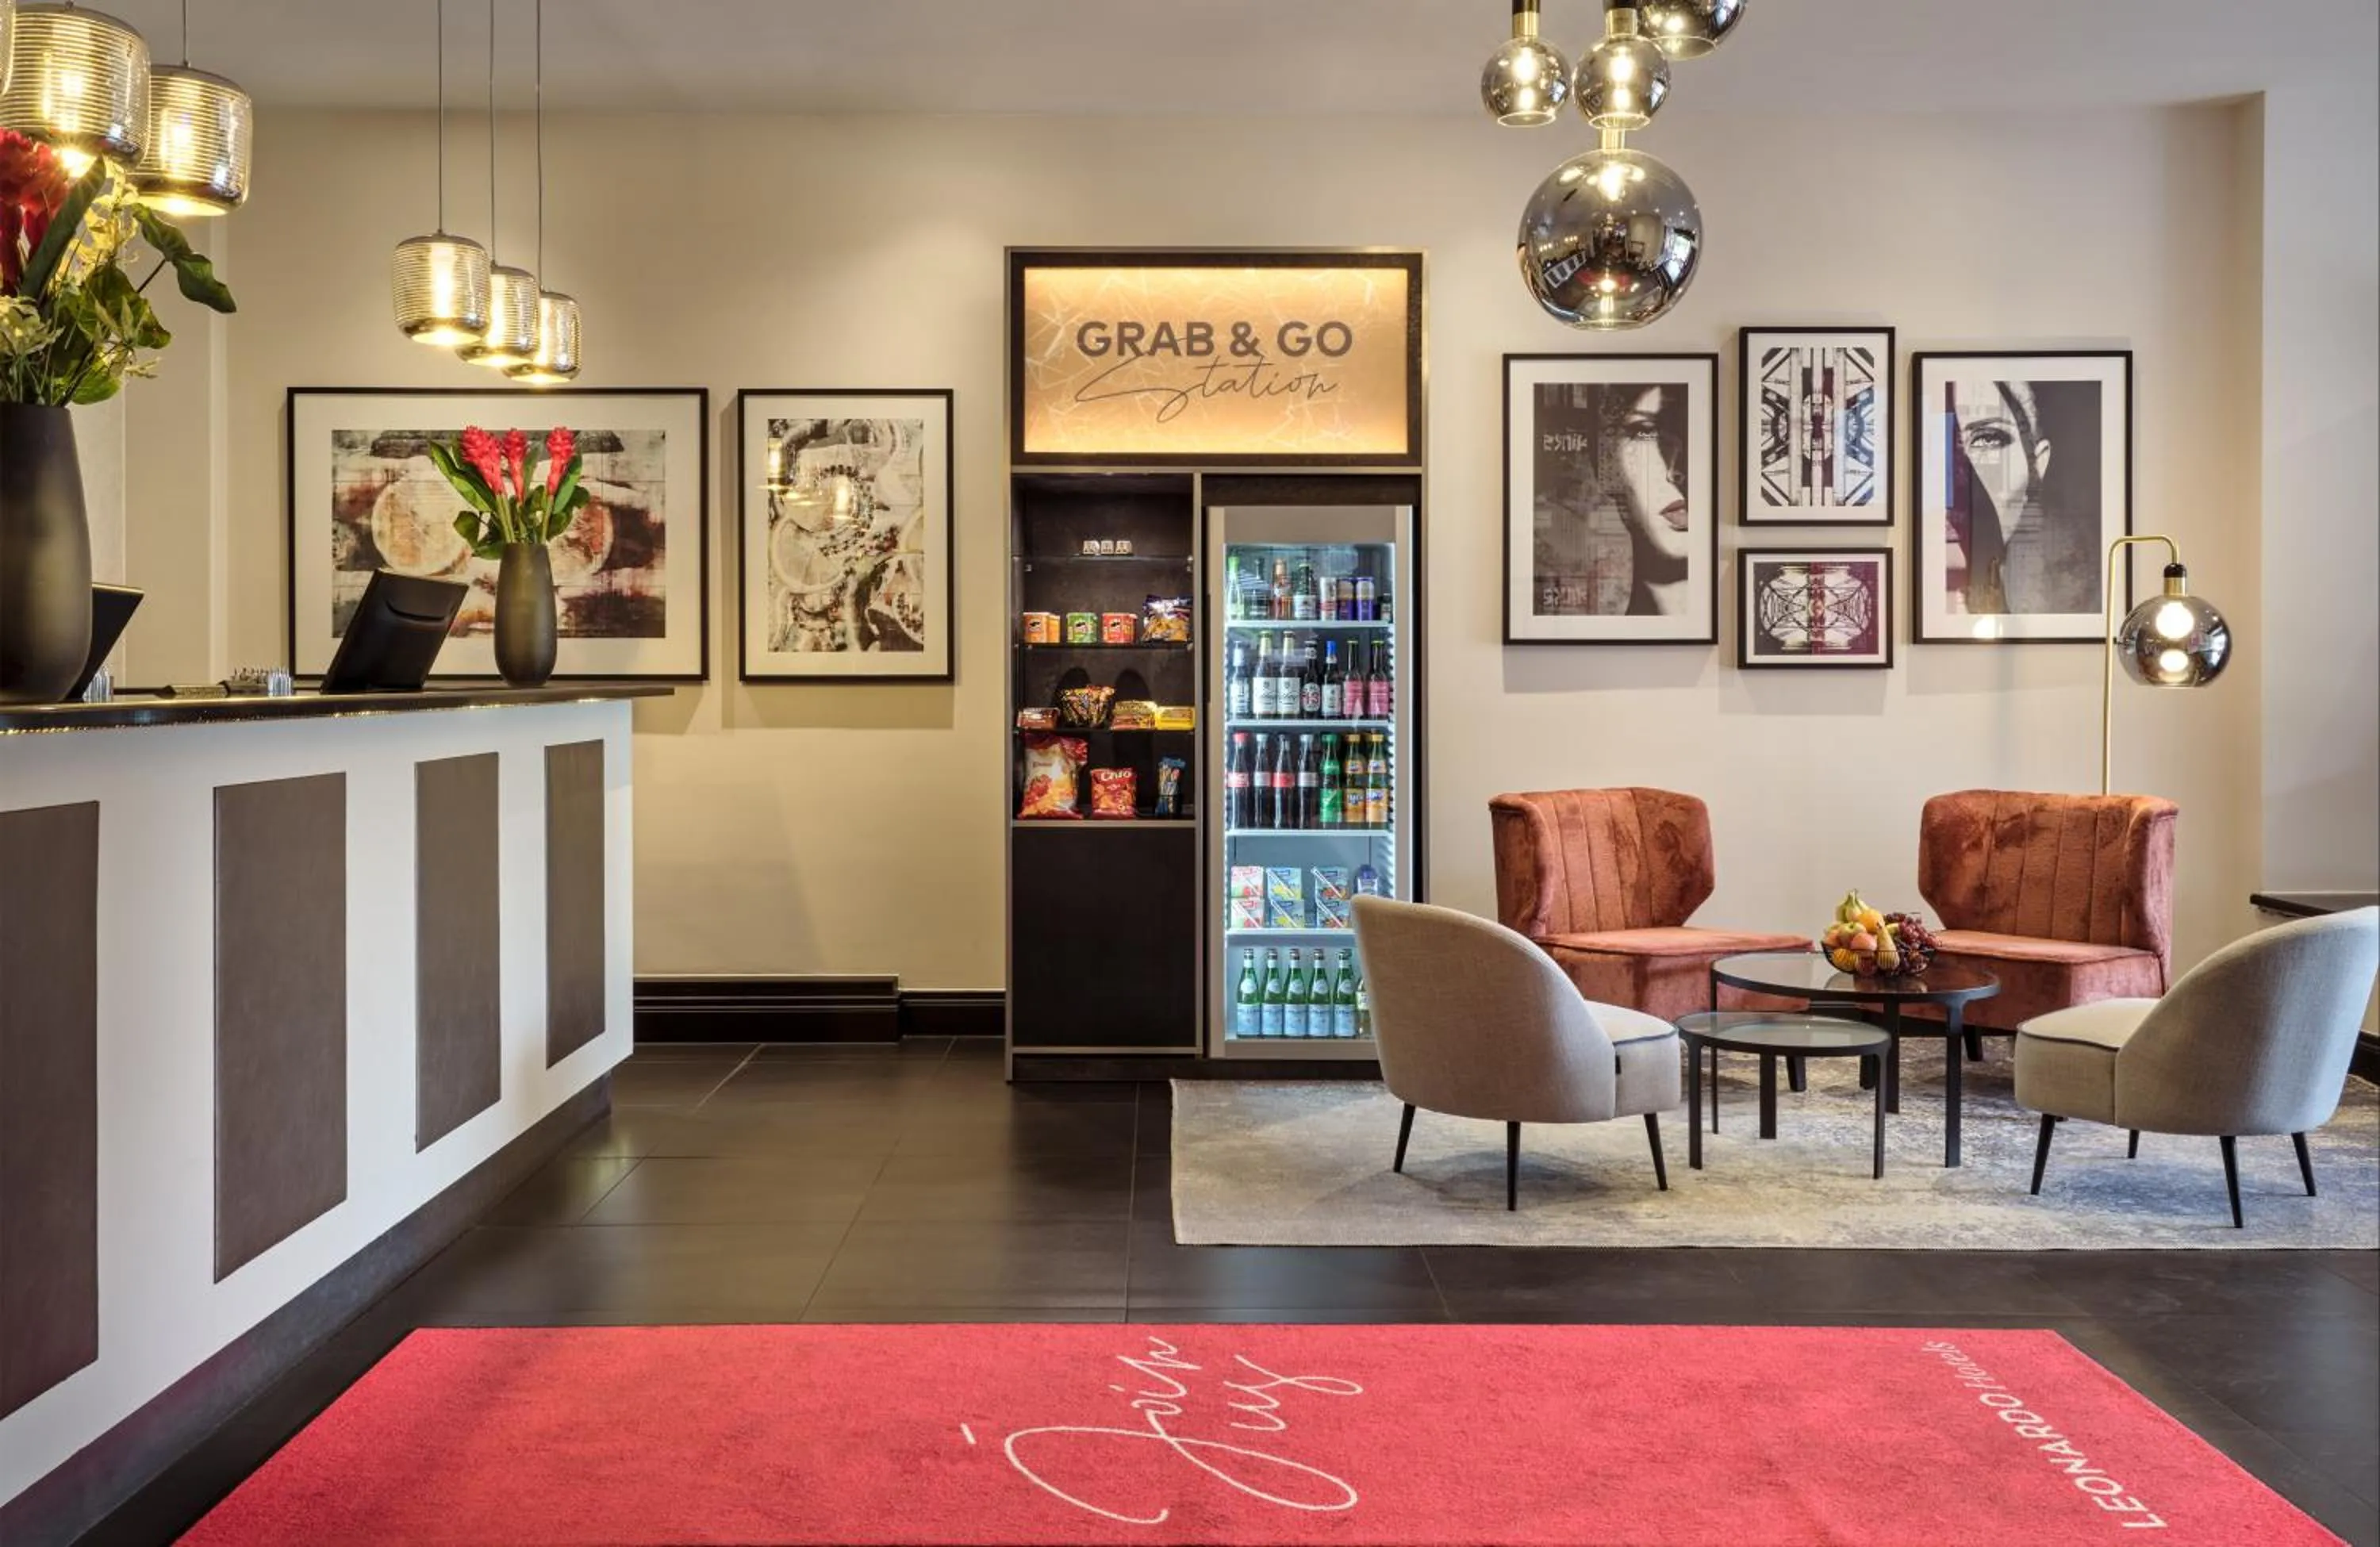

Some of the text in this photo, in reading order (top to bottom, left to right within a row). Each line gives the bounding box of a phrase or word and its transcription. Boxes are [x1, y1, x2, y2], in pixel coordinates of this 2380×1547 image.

[1077, 321, 1353, 357] GRAB & GO
[1074, 344, 1338, 424] Station
[1979, 1392, 2168, 1529] LEONARDO
